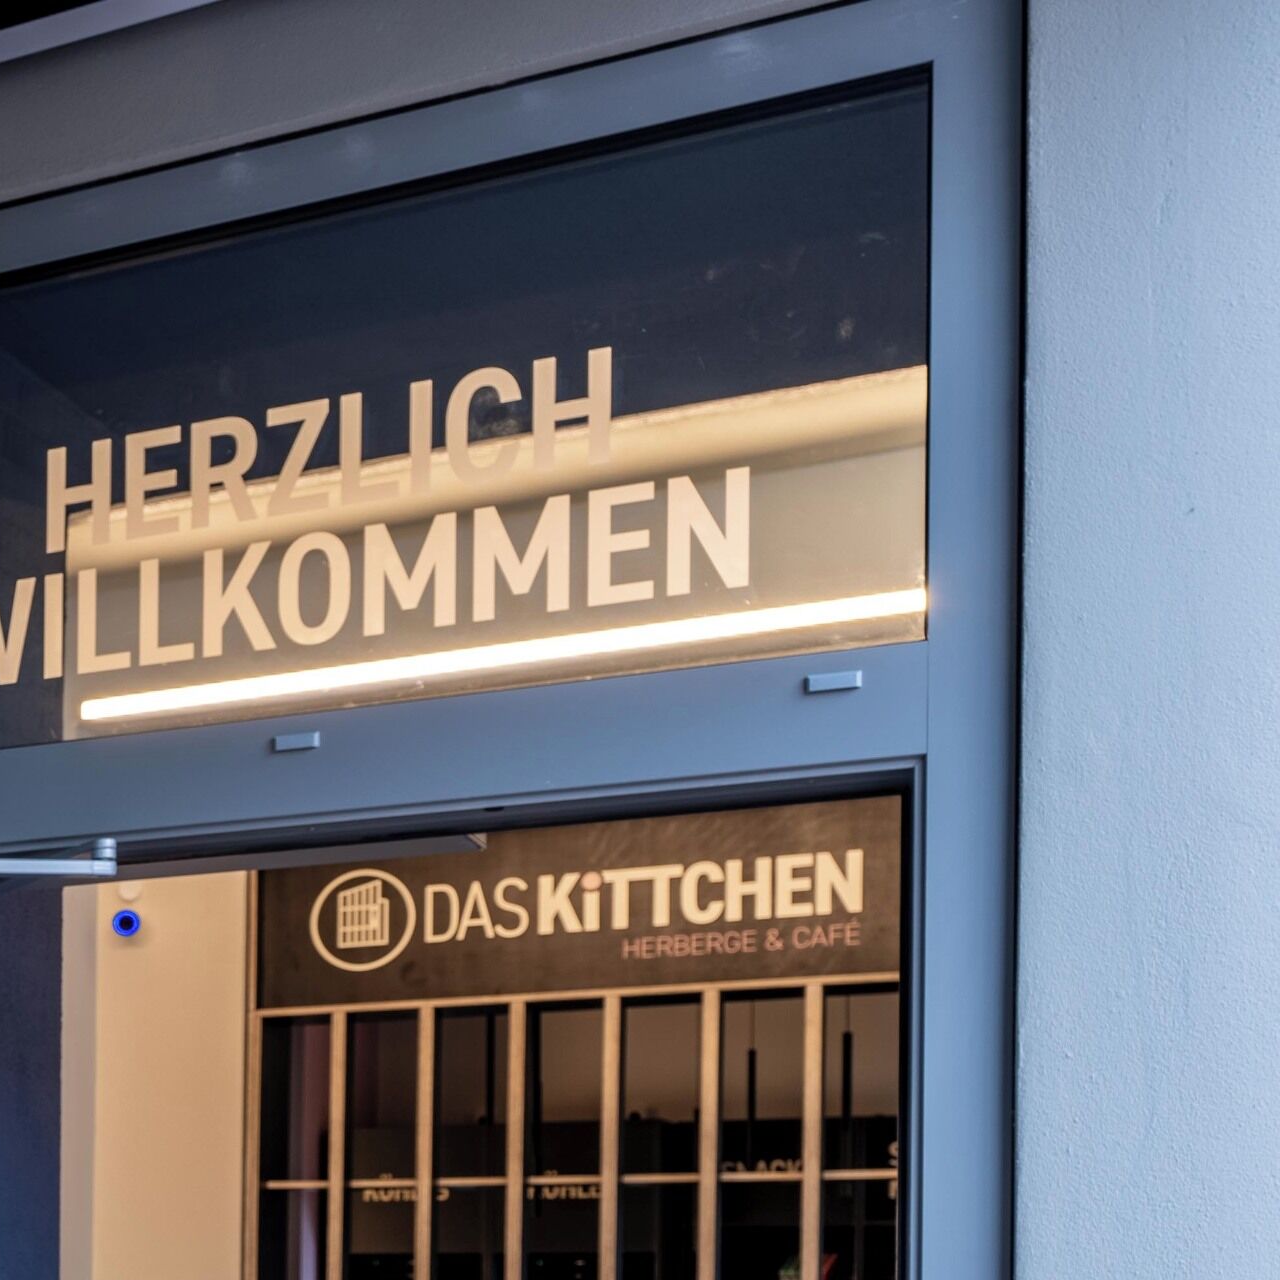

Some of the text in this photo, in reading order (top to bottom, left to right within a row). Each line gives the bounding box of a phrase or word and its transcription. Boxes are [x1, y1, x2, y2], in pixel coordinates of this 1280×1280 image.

[45, 346, 613, 553] HERZLICH
[621, 928, 757, 960] HERBERGE
[764, 927, 784, 951] &
